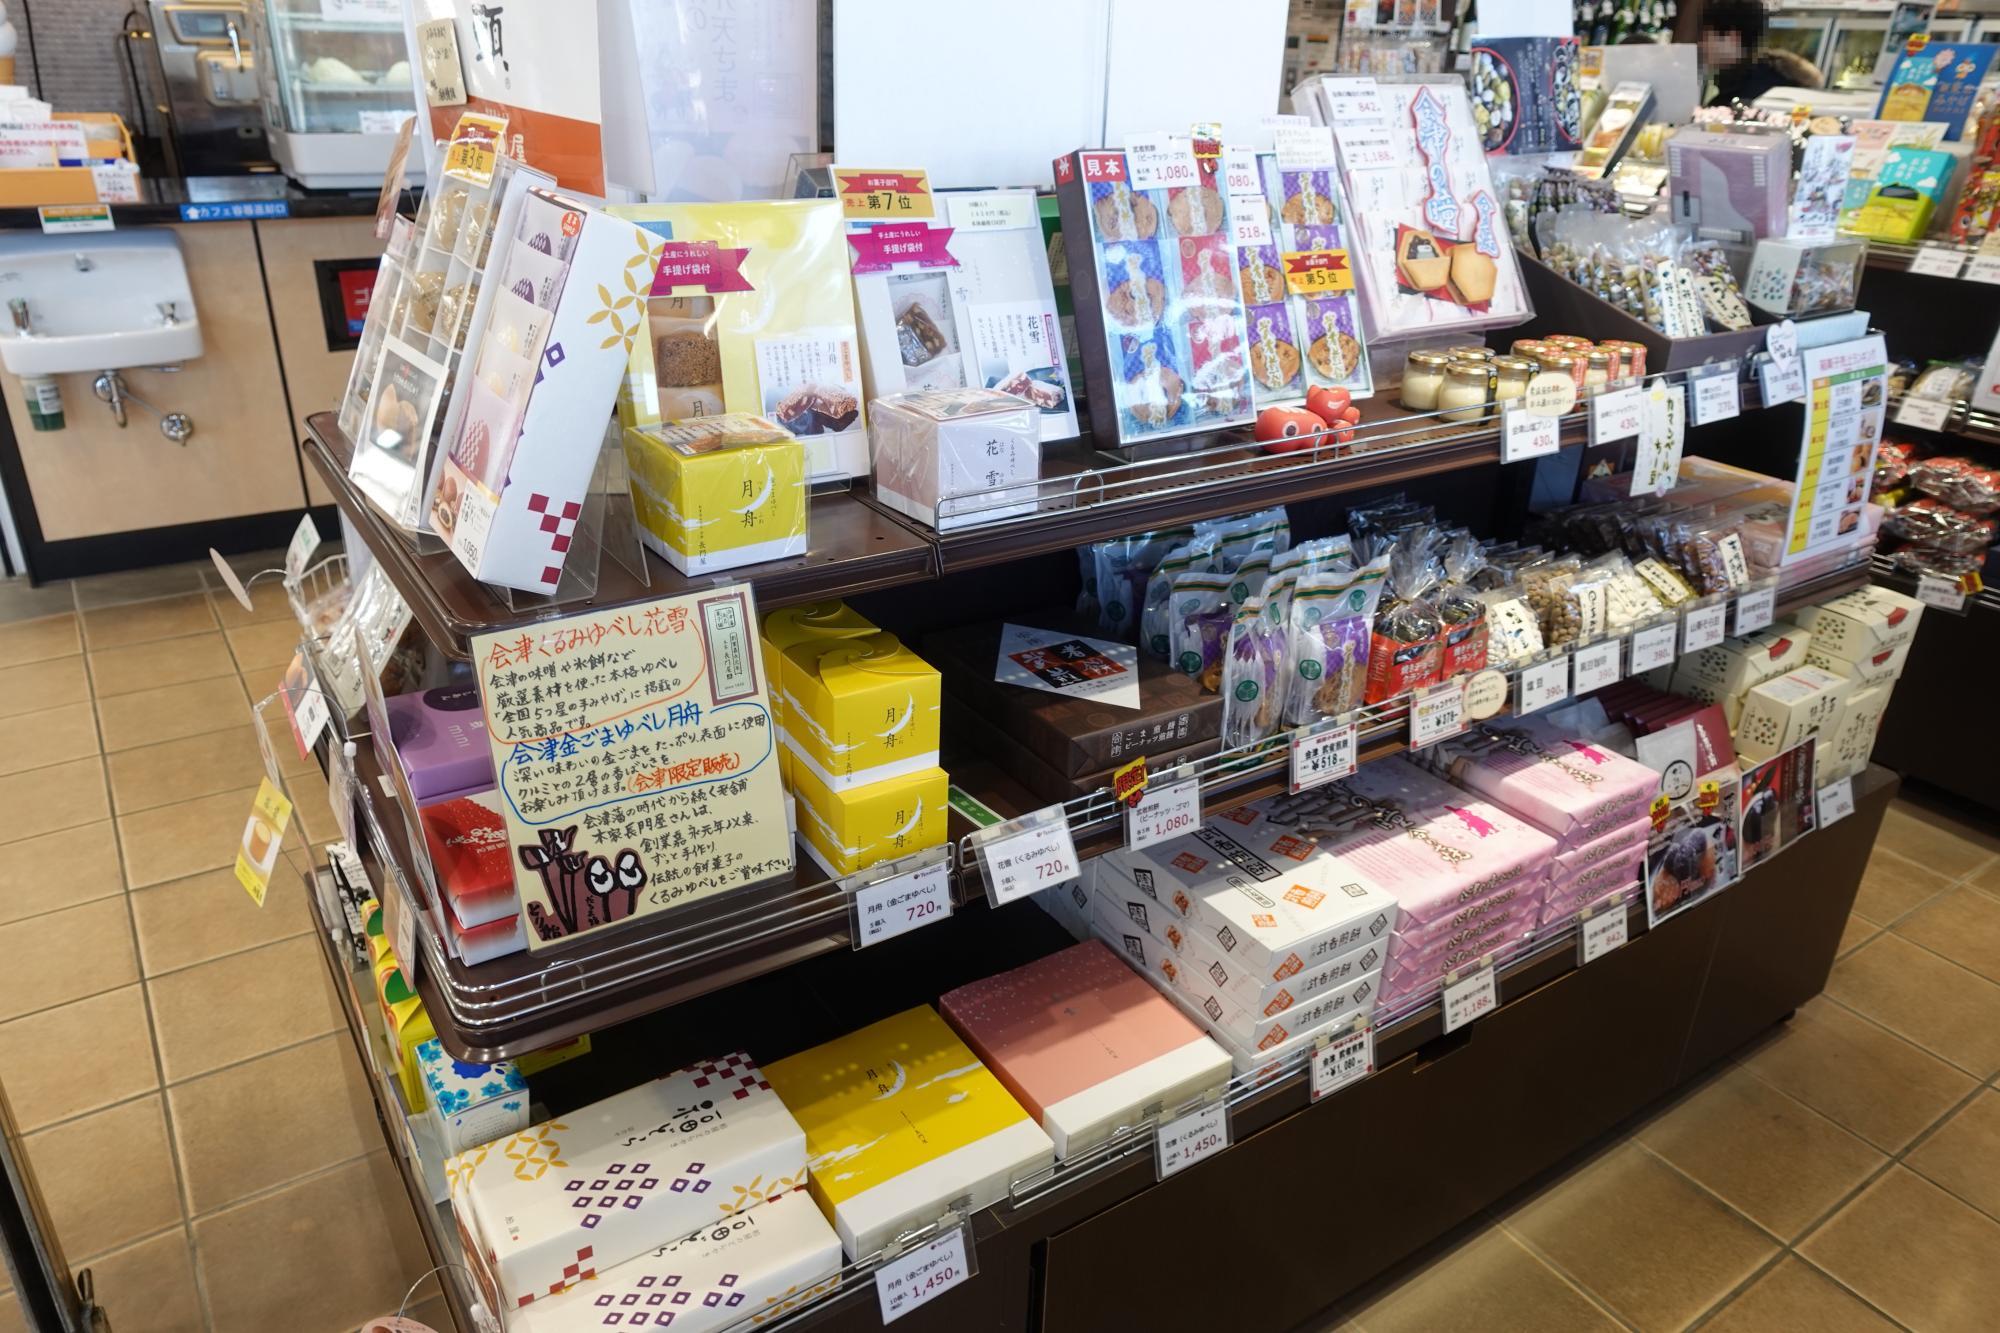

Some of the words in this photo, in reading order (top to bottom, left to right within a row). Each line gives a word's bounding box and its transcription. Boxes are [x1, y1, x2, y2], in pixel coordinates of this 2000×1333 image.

[1085, 159, 1121, 177] 見本
[867, 192, 912, 210] 第7位
[877, 229, 921, 240] 手土産にうれしい
[660, 250, 709, 260] 土産にうれしい
[883, 243, 924, 255] 手提げ袋付
[662, 263, 711, 276] 手提げ袋付
[1306, 269, 1338, 286] 第5位
[985, 439, 999, 487] 花雪
[741, 479, 758, 528] 月舟
[490, 605, 689, 669] 会津くるみゆべし花雪
[490, 648, 636, 689] 会津の味噌や氷餅など
[496, 658, 678, 710] 厳選素材を使った本格ゆべし
[448, 724, 471, 748] mini
[506, 716, 592, 740] 人気商品です。
[509, 701, 703, 766] 会津金ごまゆべし月舟
[883, 707, 898, 749] 月舟
[520, 782, 626, 814] お楽しみ頂けます。
[583, 778, 748, 830] 会津藩の時代から続く老舗
[893, 809, 906, 848] 月舟
[1155, 814, 1194, 836] 1,080円
[650, 852, 744, 887] 伝統の餅菓子の
[1035, 859, 1070, 881] 720円
[906, 900, 942, 921] 720円
[866, 1068, 890, 1095] 月舟
[1183, 1133, 1222, 1159] 1,450円
[912, 1267, 960, 1298] 1,450円
